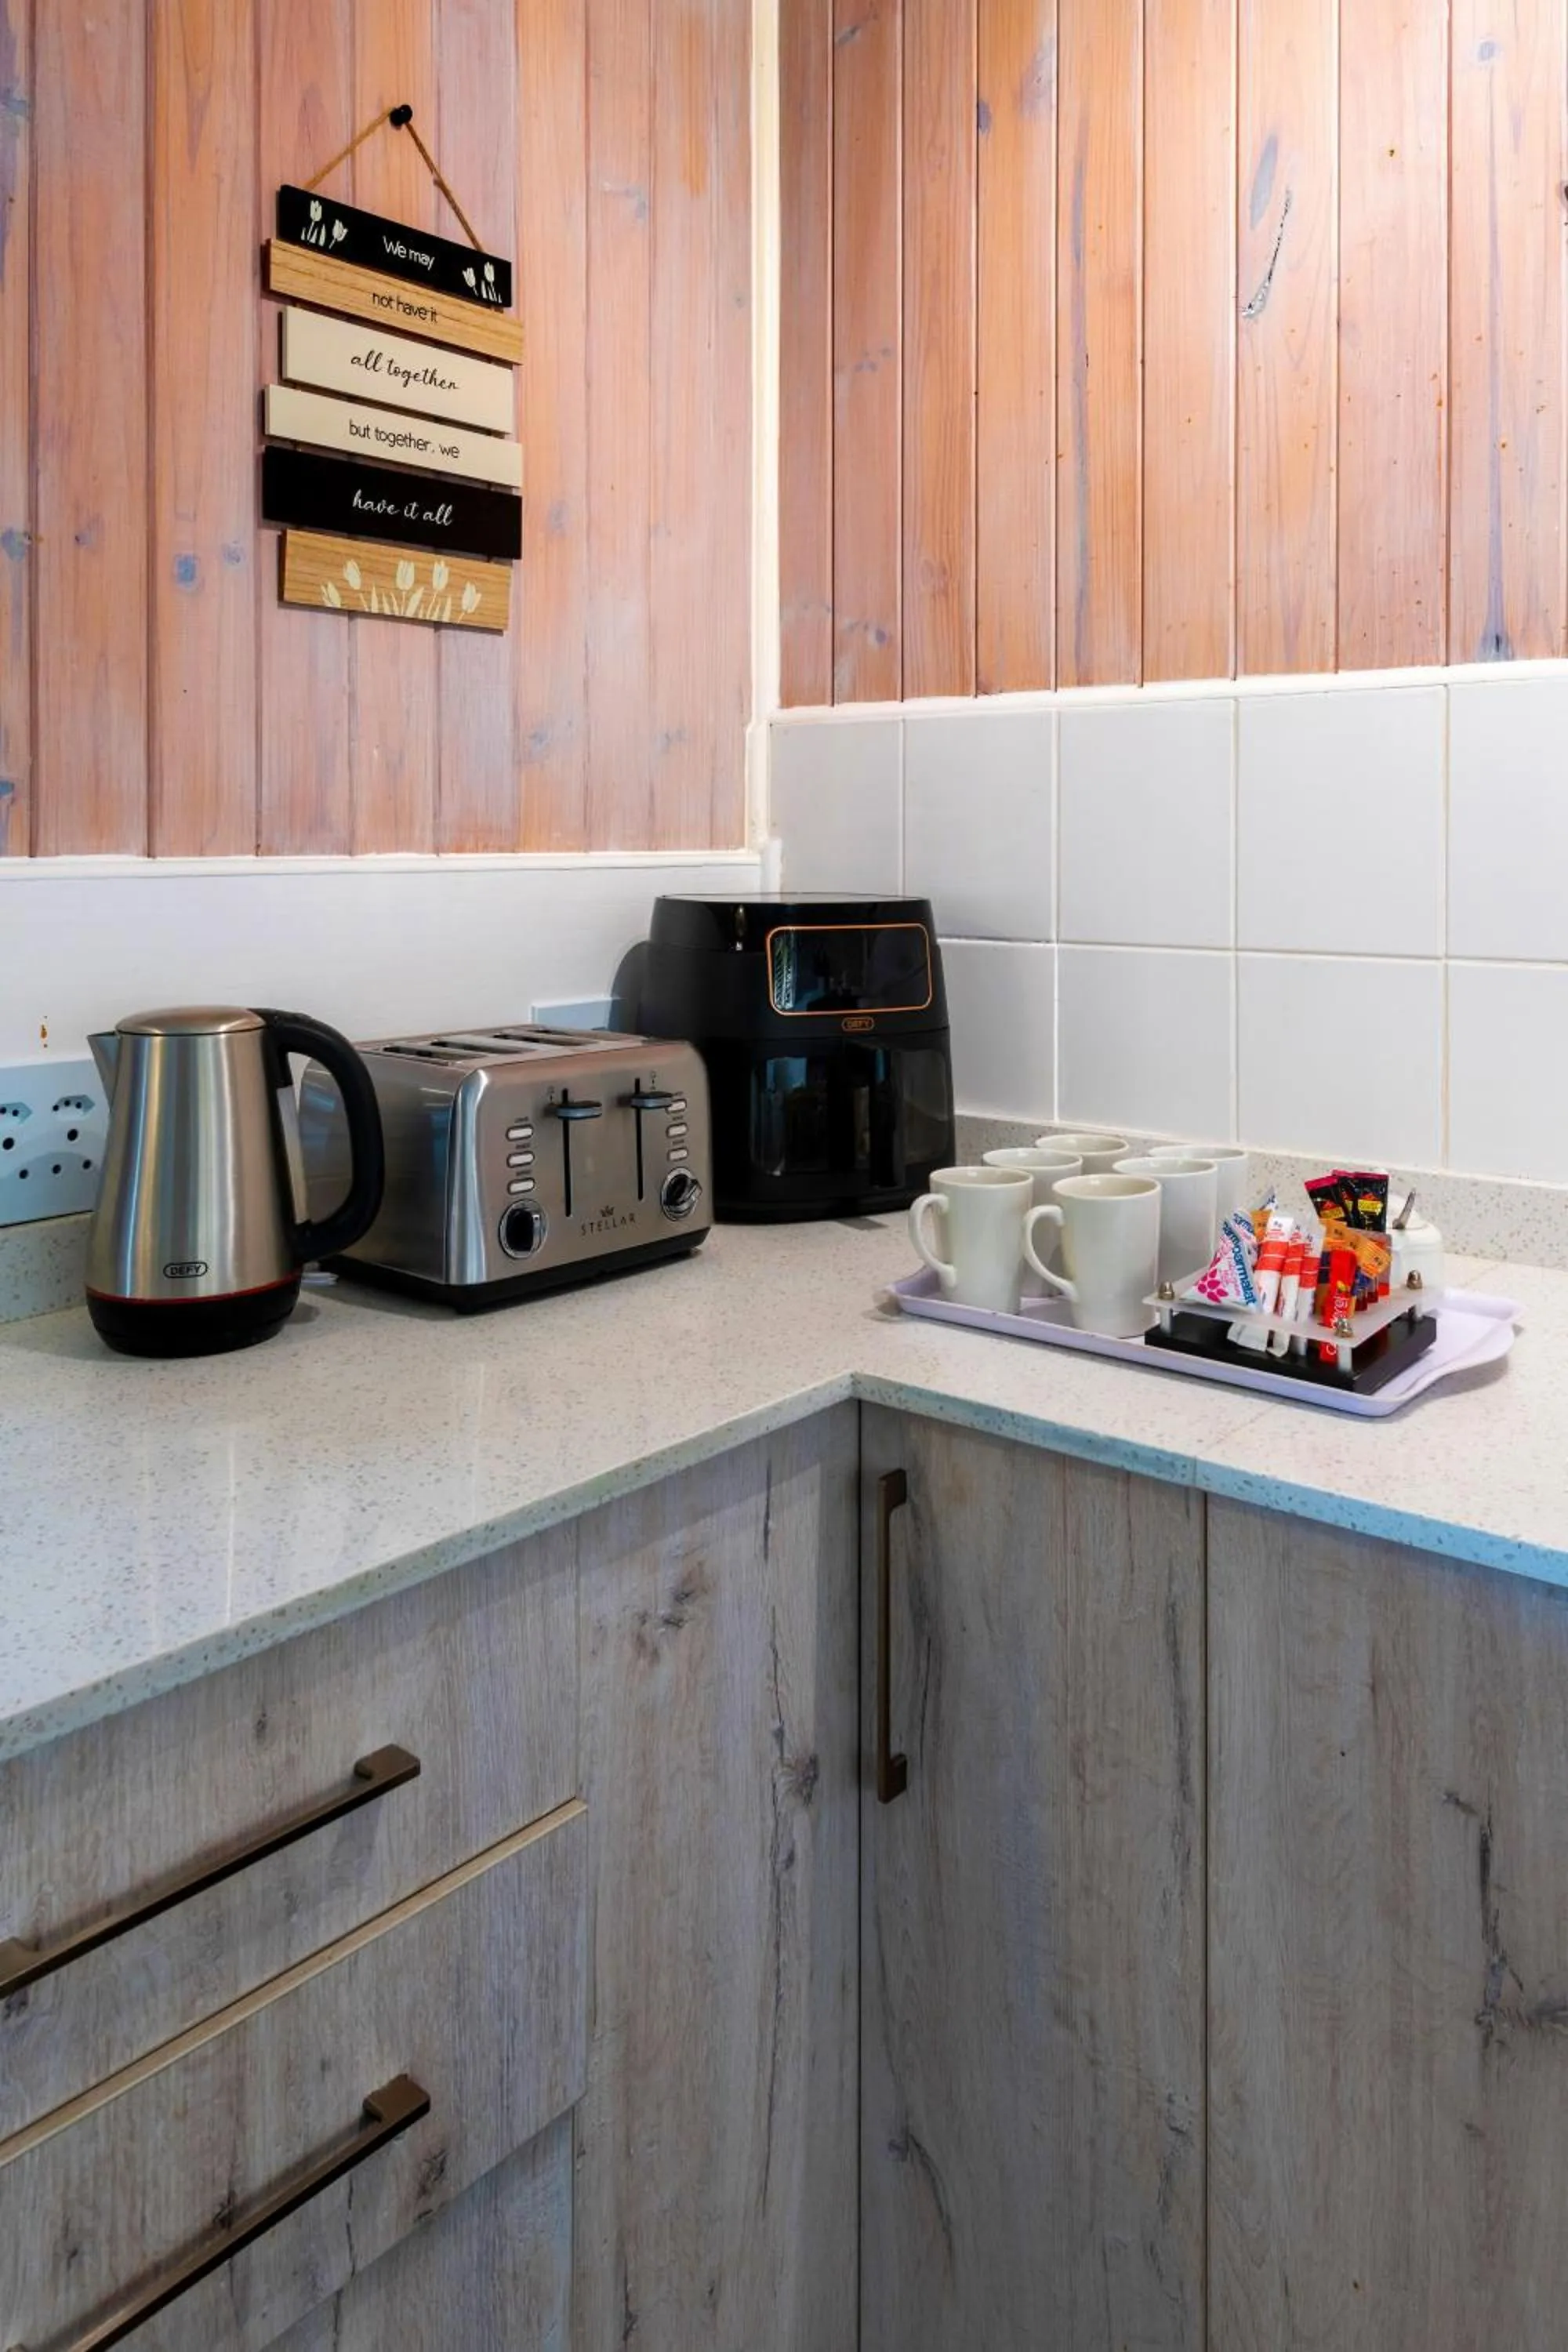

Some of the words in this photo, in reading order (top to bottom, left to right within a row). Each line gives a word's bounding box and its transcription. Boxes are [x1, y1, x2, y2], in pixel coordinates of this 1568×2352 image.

[382, 235, 407, 258] We
[408, 249, 435, 270] may
[372, 292, 394, 309] not
[397, 296, 427, 320] have
[430, 308, 438, 324] it
[350, 350, 382, 372] all
[387, 362, 459, 390] together
[349, 419, 370, 438] but
[439, 444, 460, 459] we
[353, 489, 399, 516] have
[404, 502, 419, 519] it
[423, 503, 453, 526] all
[580, 1212, 637, 1236] STELLAR
[169, 1264, 201, 1276] DEFY
